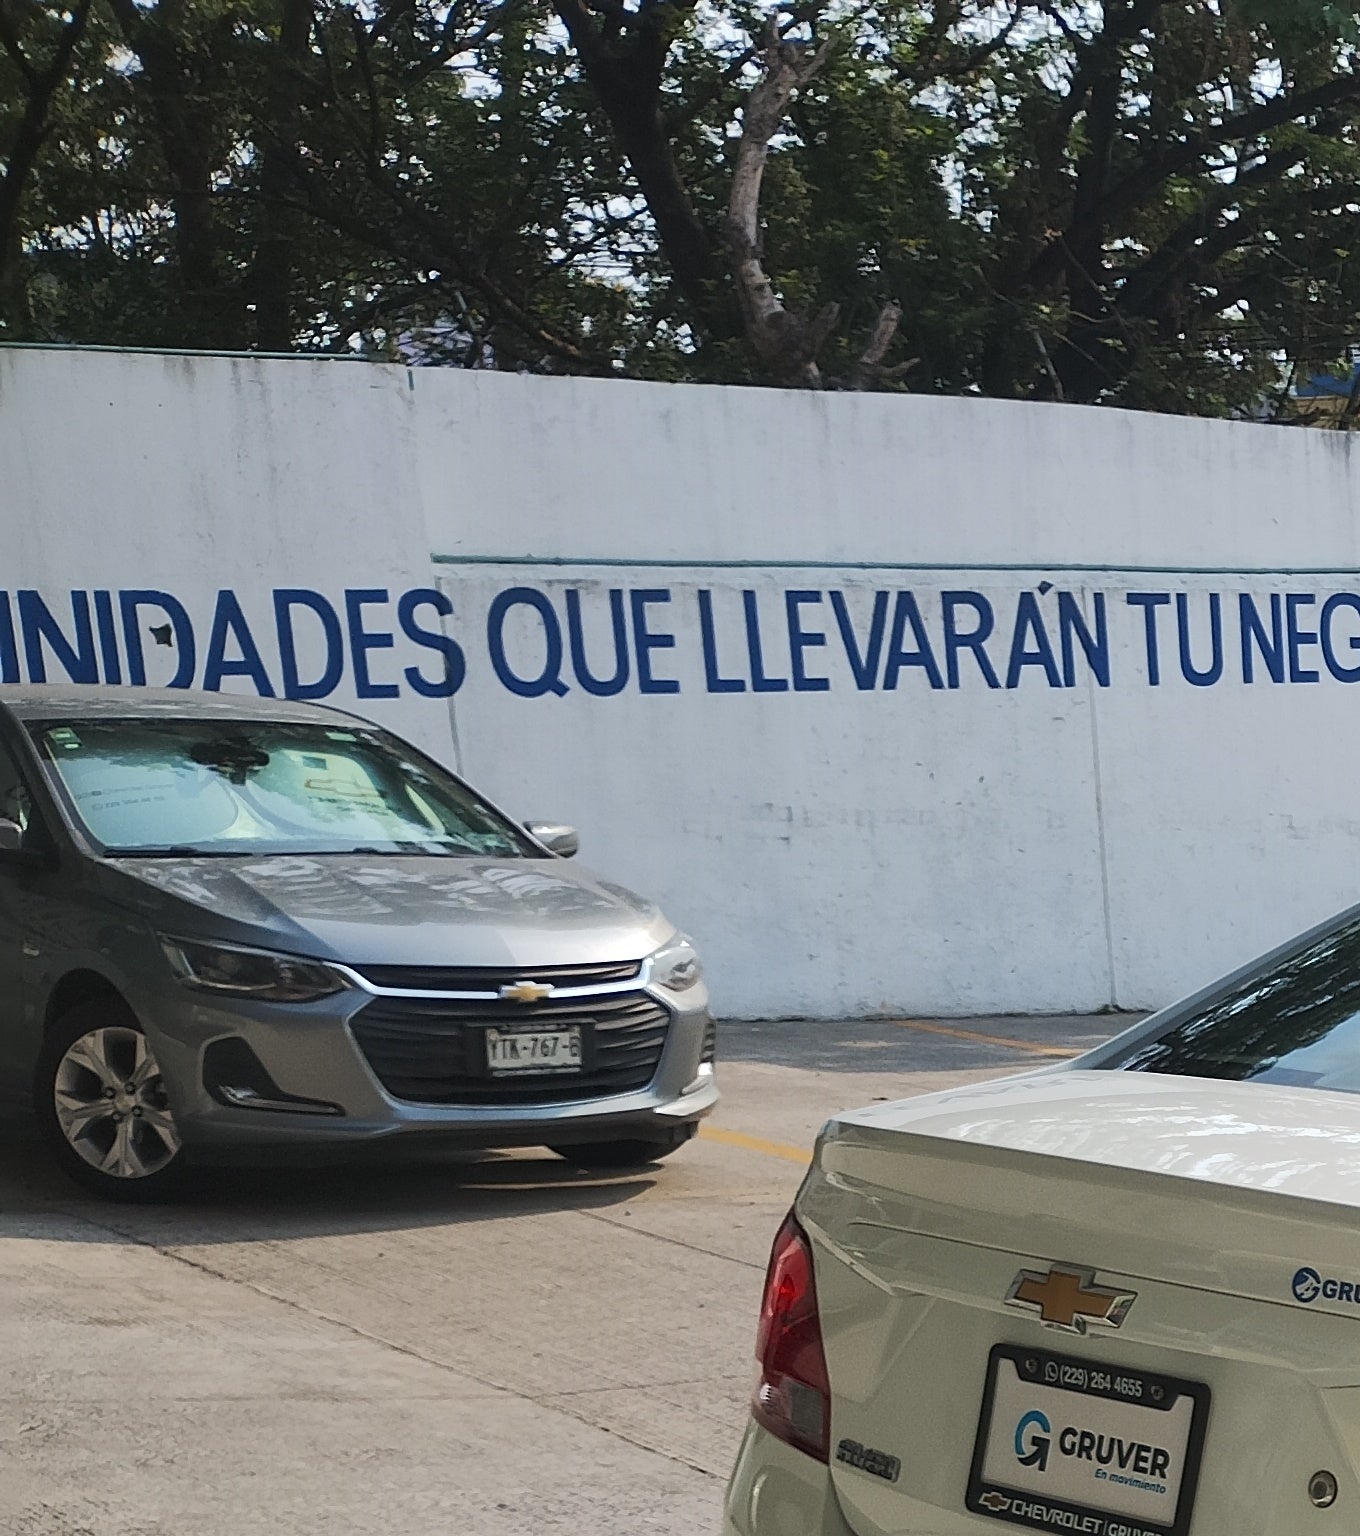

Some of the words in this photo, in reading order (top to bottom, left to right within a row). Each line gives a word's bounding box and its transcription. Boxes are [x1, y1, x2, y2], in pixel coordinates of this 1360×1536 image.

[487, 585, 681, 698] QUE
[697, 579, 1112, 694] LLEVARÁN
[1126, 591, 1224, 688] TU
[1060, 1365, 1088, 1389] (229)
[1090, 1371, 1112, 1391] 264
[1113, 1376, 1143, 1398] 4655
[1059, 1426, 1171, 1479] GRUVER
[1094, 1468, 1108, 1480] En
[1108, 1472, 1167, 1495] movimiento
[1011, 1498, 1104, 1535] CHEVROLET
